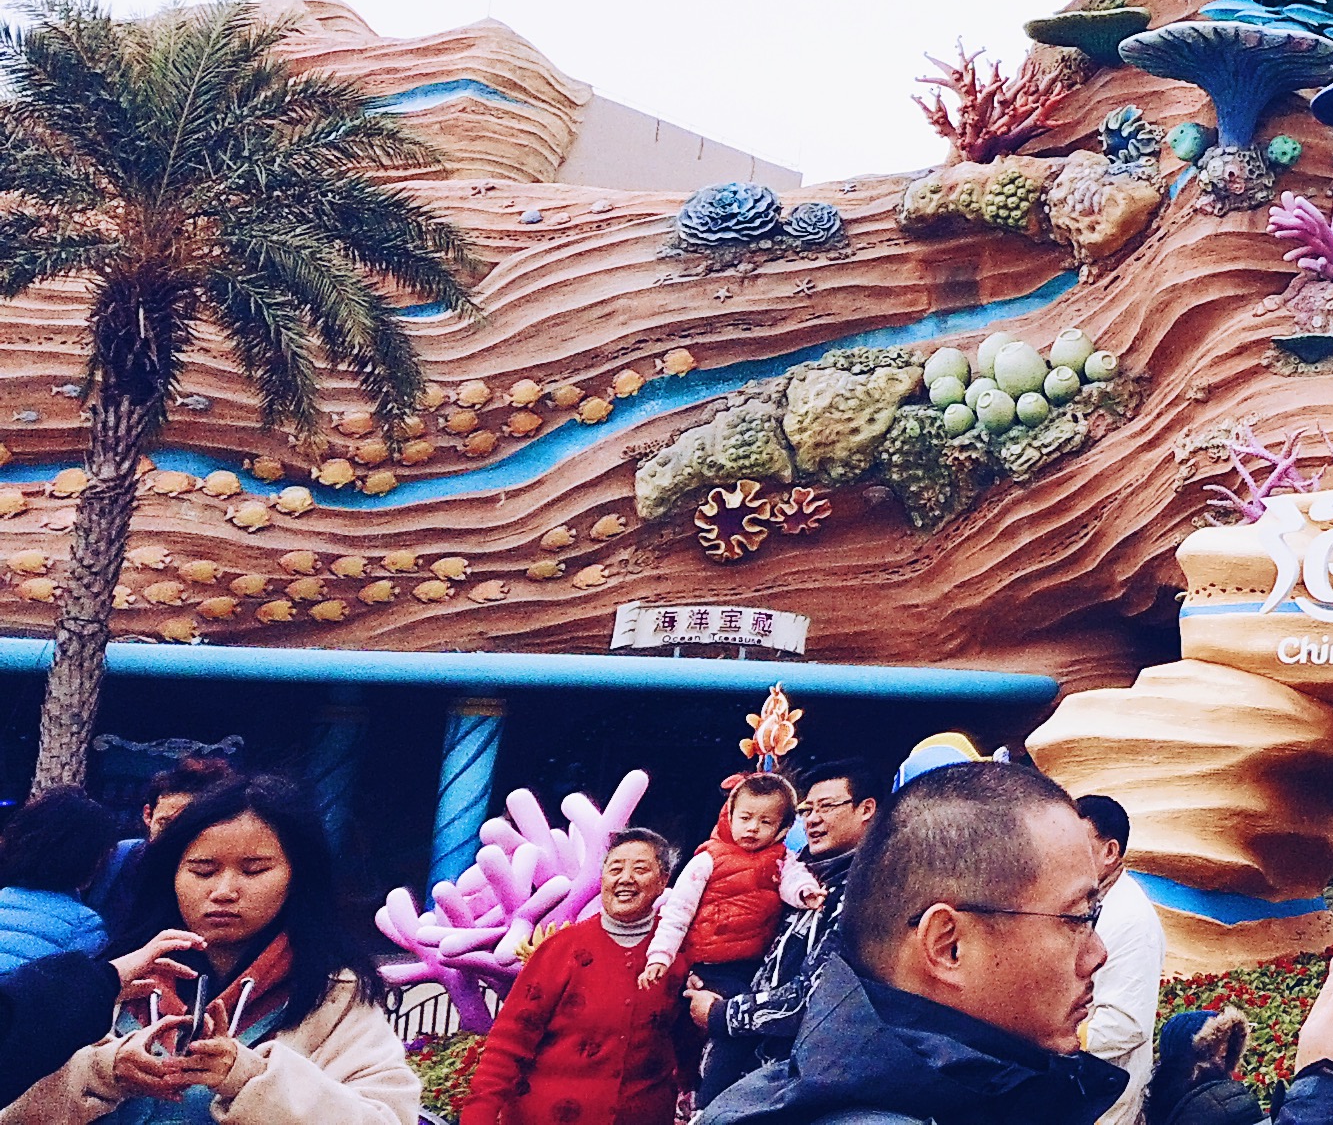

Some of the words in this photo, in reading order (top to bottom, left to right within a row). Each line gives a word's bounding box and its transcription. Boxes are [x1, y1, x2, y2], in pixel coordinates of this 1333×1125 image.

[654, 609, 774, 636] 海洋宝藏
[662, 635, 701, 644] Ocean
[711, 632, 762, 644] Treasure
